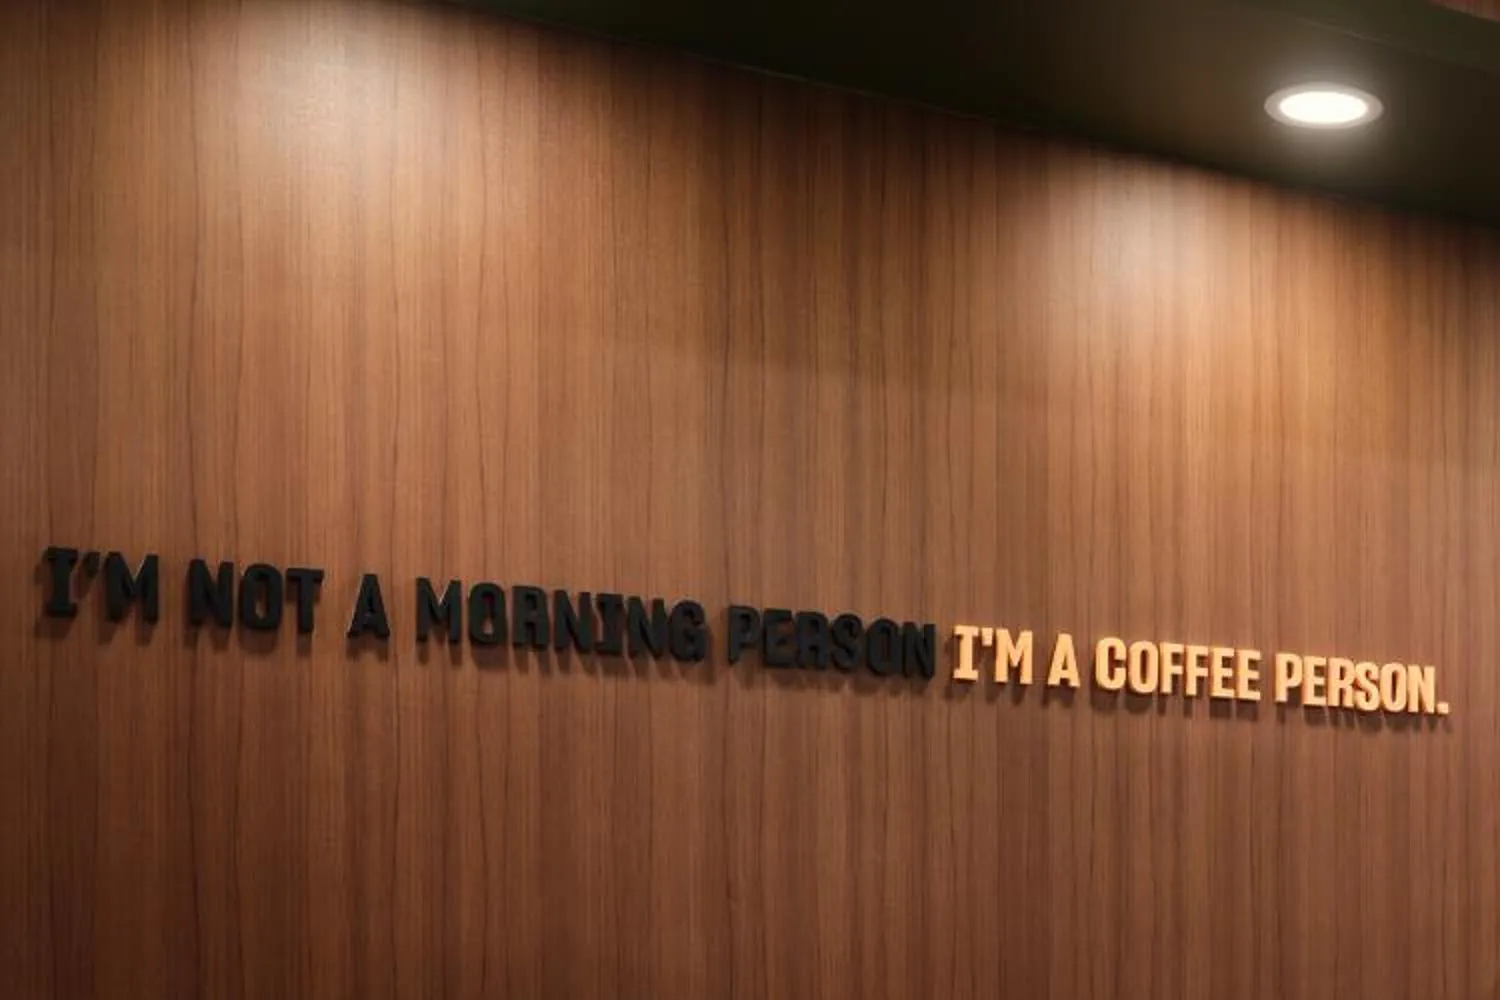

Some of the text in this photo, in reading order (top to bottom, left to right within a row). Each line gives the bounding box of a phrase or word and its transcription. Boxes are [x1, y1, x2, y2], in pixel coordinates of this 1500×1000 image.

[46, 546, 1450, 716] I'M NOT A MORNING PERSON I'M A COFFEE PERSON.
